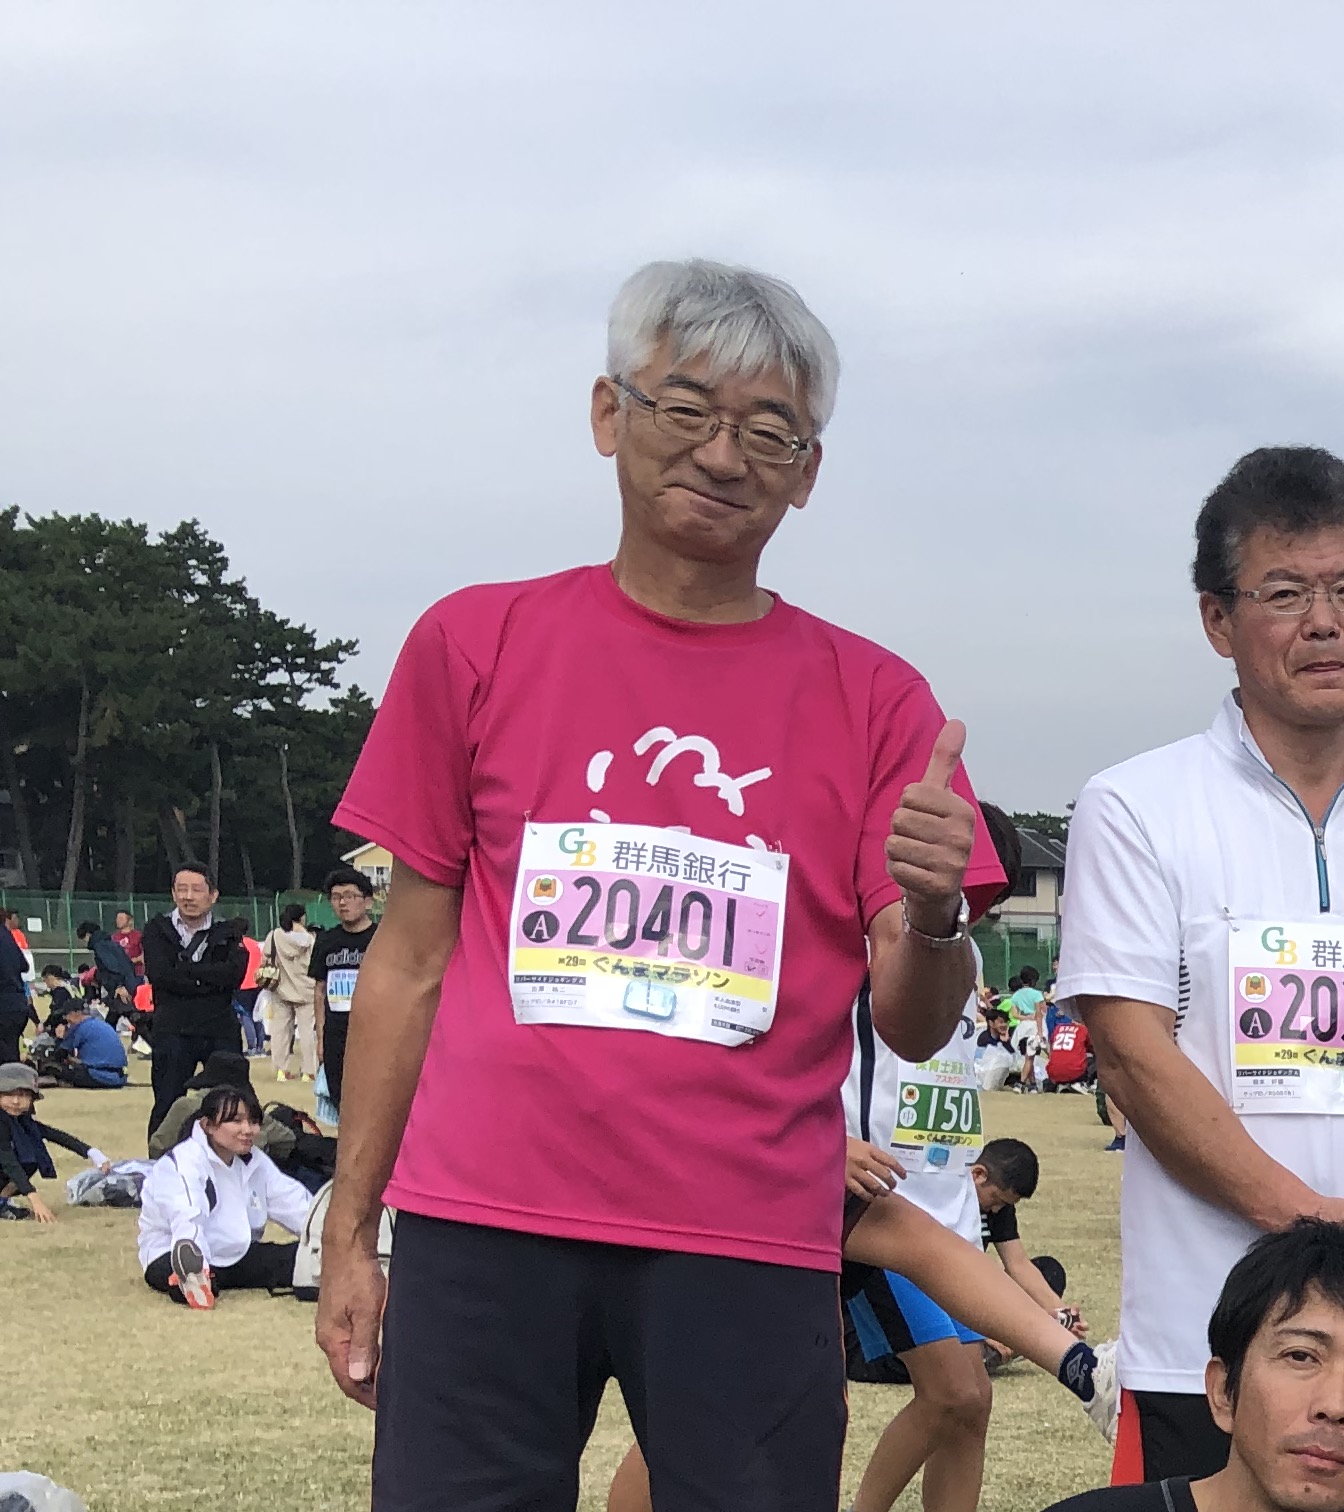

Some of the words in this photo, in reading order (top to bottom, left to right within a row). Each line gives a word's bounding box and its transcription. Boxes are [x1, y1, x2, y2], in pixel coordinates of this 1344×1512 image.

[611, 840, 752, 892] 群馬銀行
[566, 875, 737, 967] 20401
[593, 956, 731, 989] ぐんまマラソン
[1053, 1033, 1077, 1051] 25
[926, 1086, 974, 1133] 150
